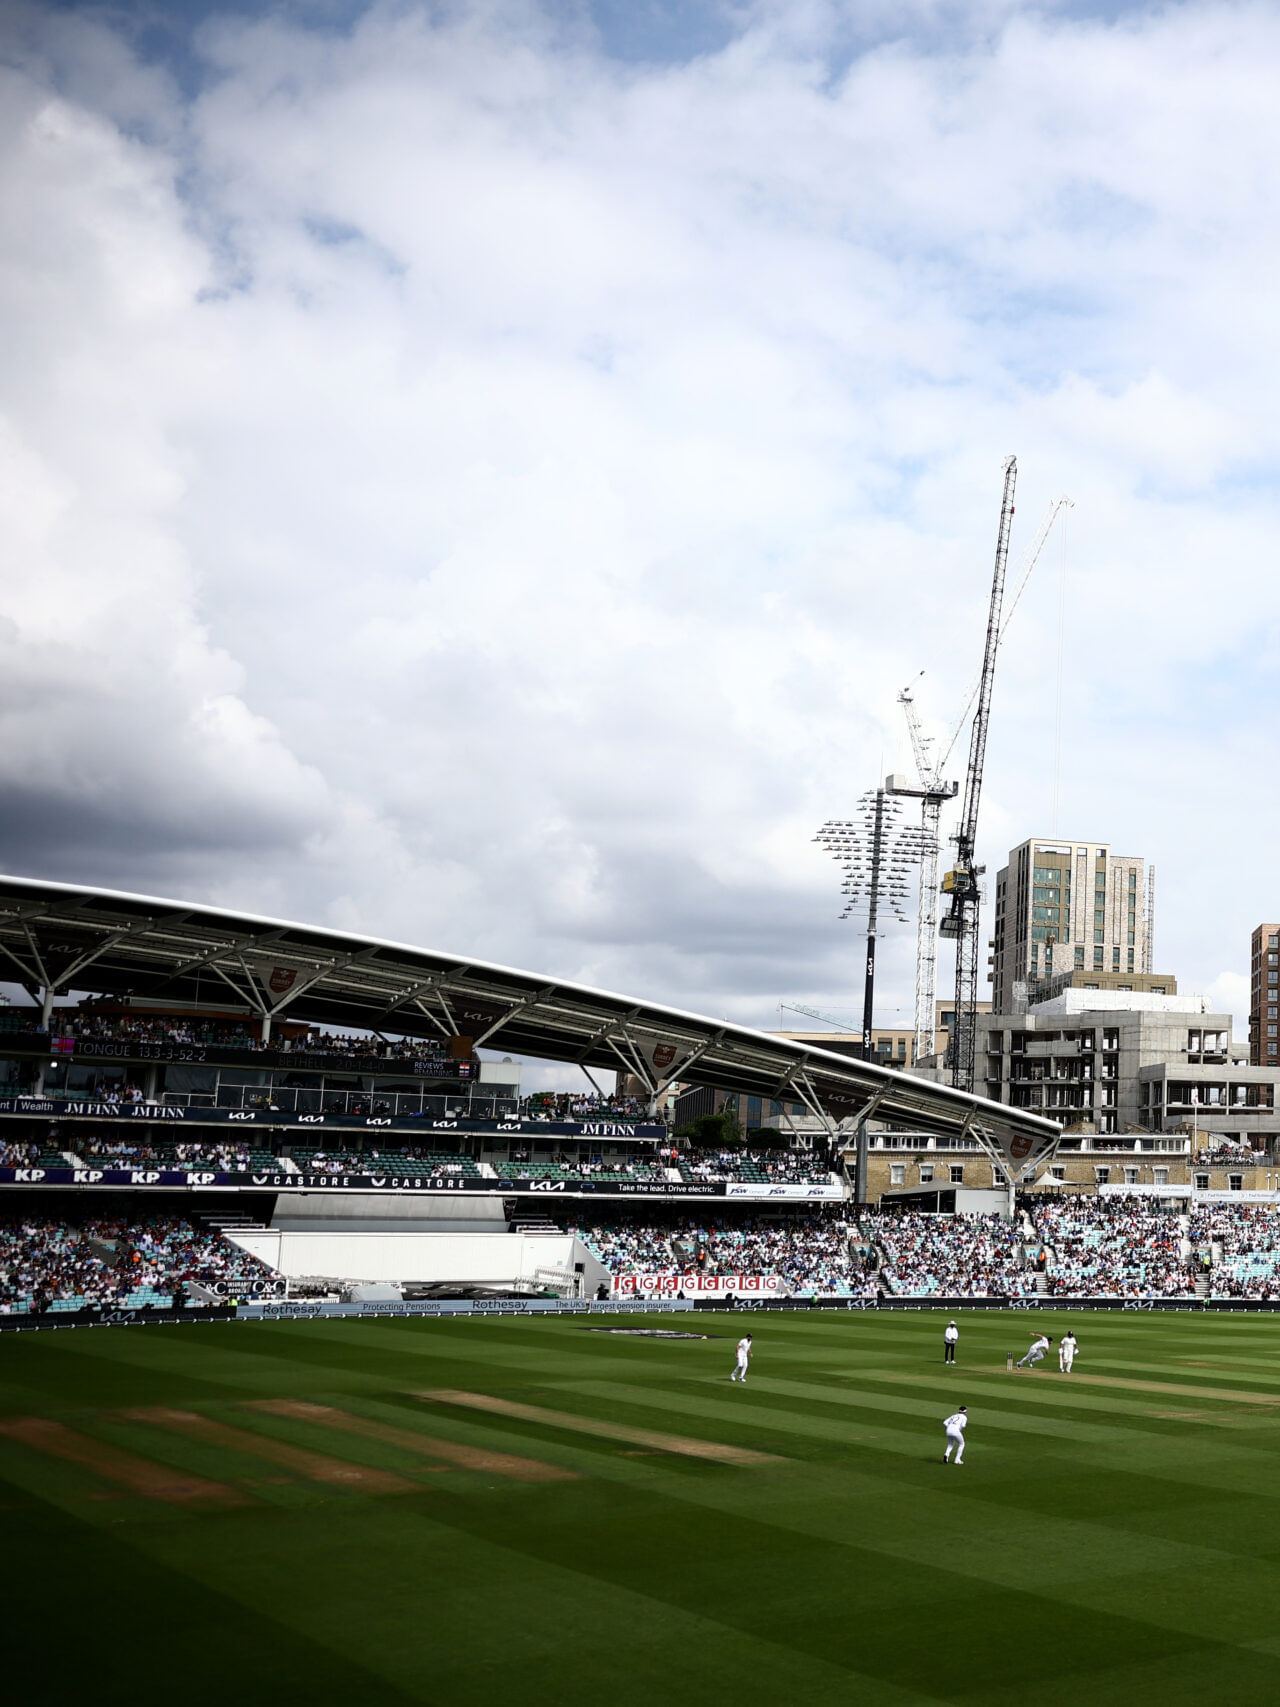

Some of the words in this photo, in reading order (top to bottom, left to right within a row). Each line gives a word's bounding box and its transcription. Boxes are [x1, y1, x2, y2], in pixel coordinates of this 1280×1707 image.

[78, 1042, 131, 1057] TONGUE
[138, 1047, 207, 1062] 13.3-3-52-2
[279, 1056, 326, 1069] BETHELL
[414, 1061, 444, 1070] REVIEWS
[21, 1101, 54, 1111] Wealth
[64, 1102, 86, 1114] JM
[87, 1103, 121, 1115] FINN
[131, 1104, 152, 1117] JM
[153, 1106, 185, 1118] FINN
[580, 1123, 603, 1136] JM
[604, 1124, 636, 1137] FINN
[14, 1169, 46, 1182] KP
[73, 1170, 104, 1183] KP
[130, 1171, 160, 1184] KP
[186, 1172, 215, 1185] KP
[273, 1174, 350, 1187] CASTORE
[391, 1177, 465, 1189] CASTORE
[618, 1183, 635, 1193] Take
[637, 1183, 648, 1193] the
[649, 1183, 665, 1193] lead.
[668, 1183, 686, 1193] Drive
[687, 1184, 716, 1194] electric.
[252, 1280, 285, 1294] C&C
[618, 1277, 634, 1289] IG
[640, 1277, 654, 1289] IG
[660, 1277, 675, 1289] IG
[682, 1277, 695, 1289] IG
[701, 1277, 716, 1289] IG
[722, 1277, 736, 1289] IG
[742, 1277, 758, 1289] IG
[763, 1277, 777, 1289] IG
[263, 1304, 322, 1316] Rothesay
[363, 1303, 403, 1312] Protecting
[405, 1302, 441, 1311] Pensions
[472, 1299, 528, 1310] Rothesay
[555, 1300, 569, 1308] The
[570, 1300, 585, 1308] UK's
[591, 1301, 616, 1311] largest
[617, 1302, 645, 1311] pension
[647, 1301, 671, 1309] insurer
